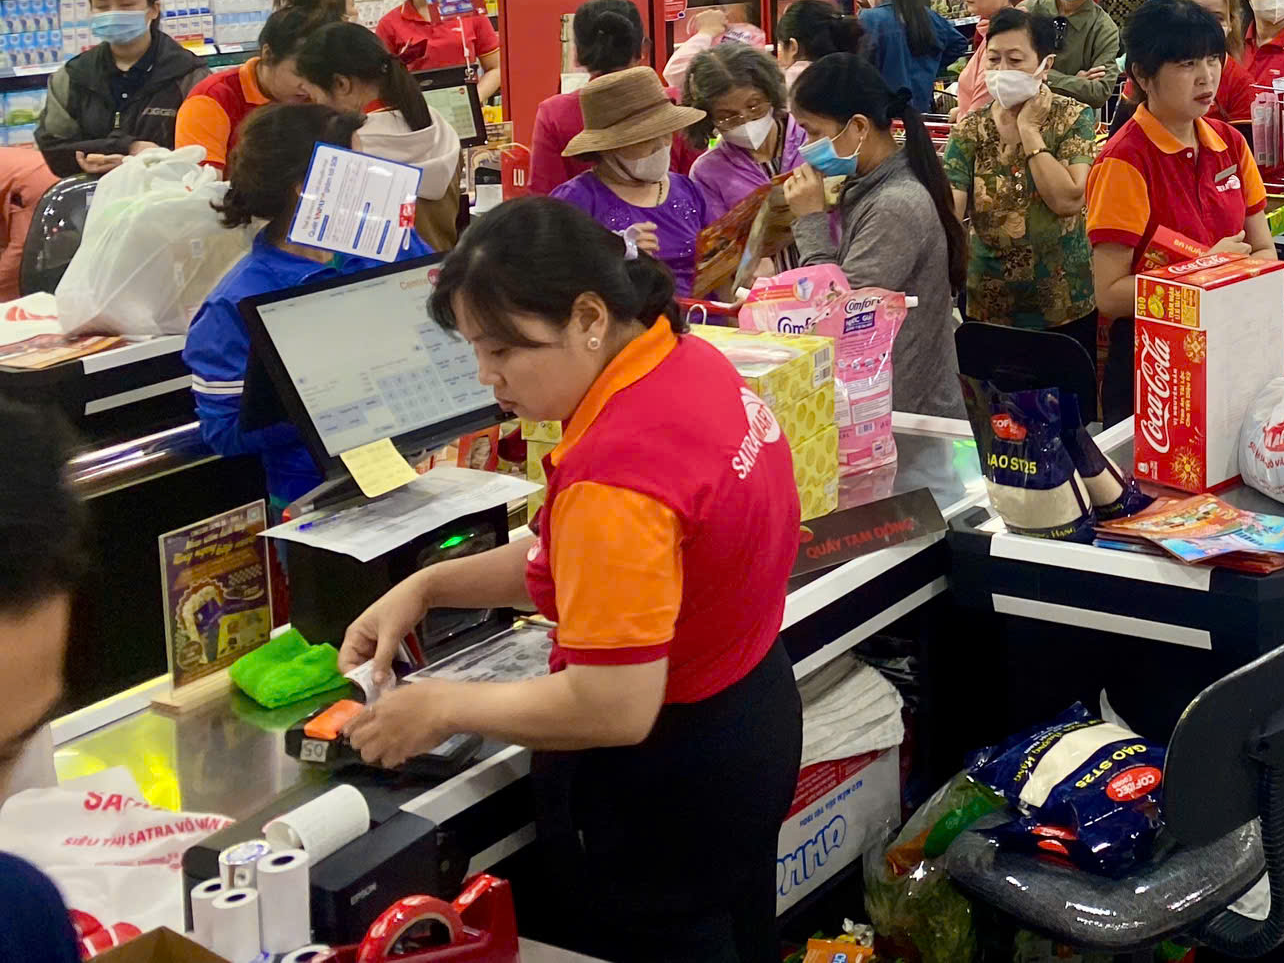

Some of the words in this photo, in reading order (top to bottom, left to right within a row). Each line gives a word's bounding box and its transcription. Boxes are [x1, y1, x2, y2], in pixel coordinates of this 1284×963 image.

[513, 168, 525, 186] LU
[1136, 296, 1147, 317] 500
[1140, 326, 1171, 454] Coca-Cola
[127, 824, 175, 846] SATRA
